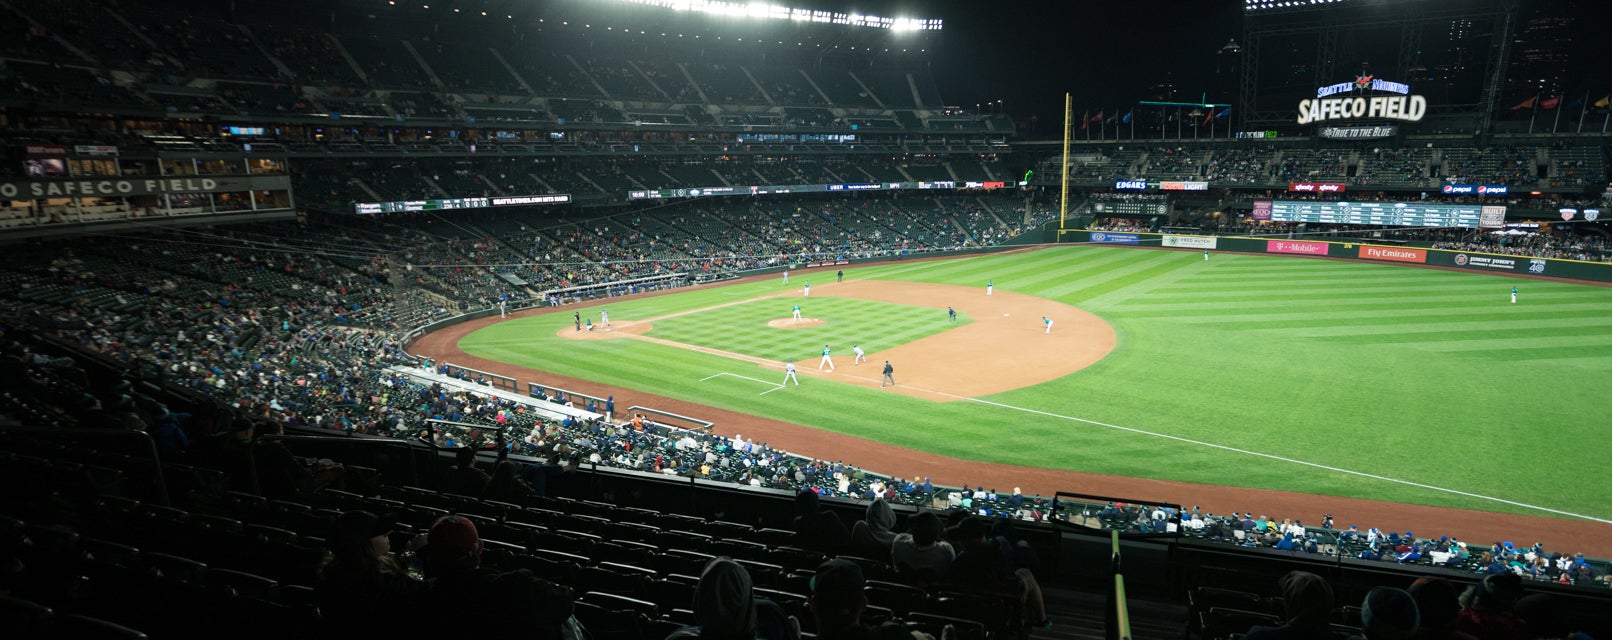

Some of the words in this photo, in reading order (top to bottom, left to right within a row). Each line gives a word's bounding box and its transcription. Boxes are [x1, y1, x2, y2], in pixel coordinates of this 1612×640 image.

[1317, 82, 1353, 98] SEATTLE
[1372, 79, 1409, 95] MARINERS
[1297, 97, 1366, 125] SAFECO
[1368, 95, 1427, 122] FIELD
[1331, 127, 1348, 138] TRUE
[1350, 128, 1358, 137] TO
[1359, 128, 1372, 137] THE
[1373, 126, 1392, 137] BLUE
[31, 180, 132, 196] SAFECO
[146, 178, 216, 192] FIELD
[1368, 249, 1380, 257] Fly
[1382, 249, 1416, 259] Emirates
